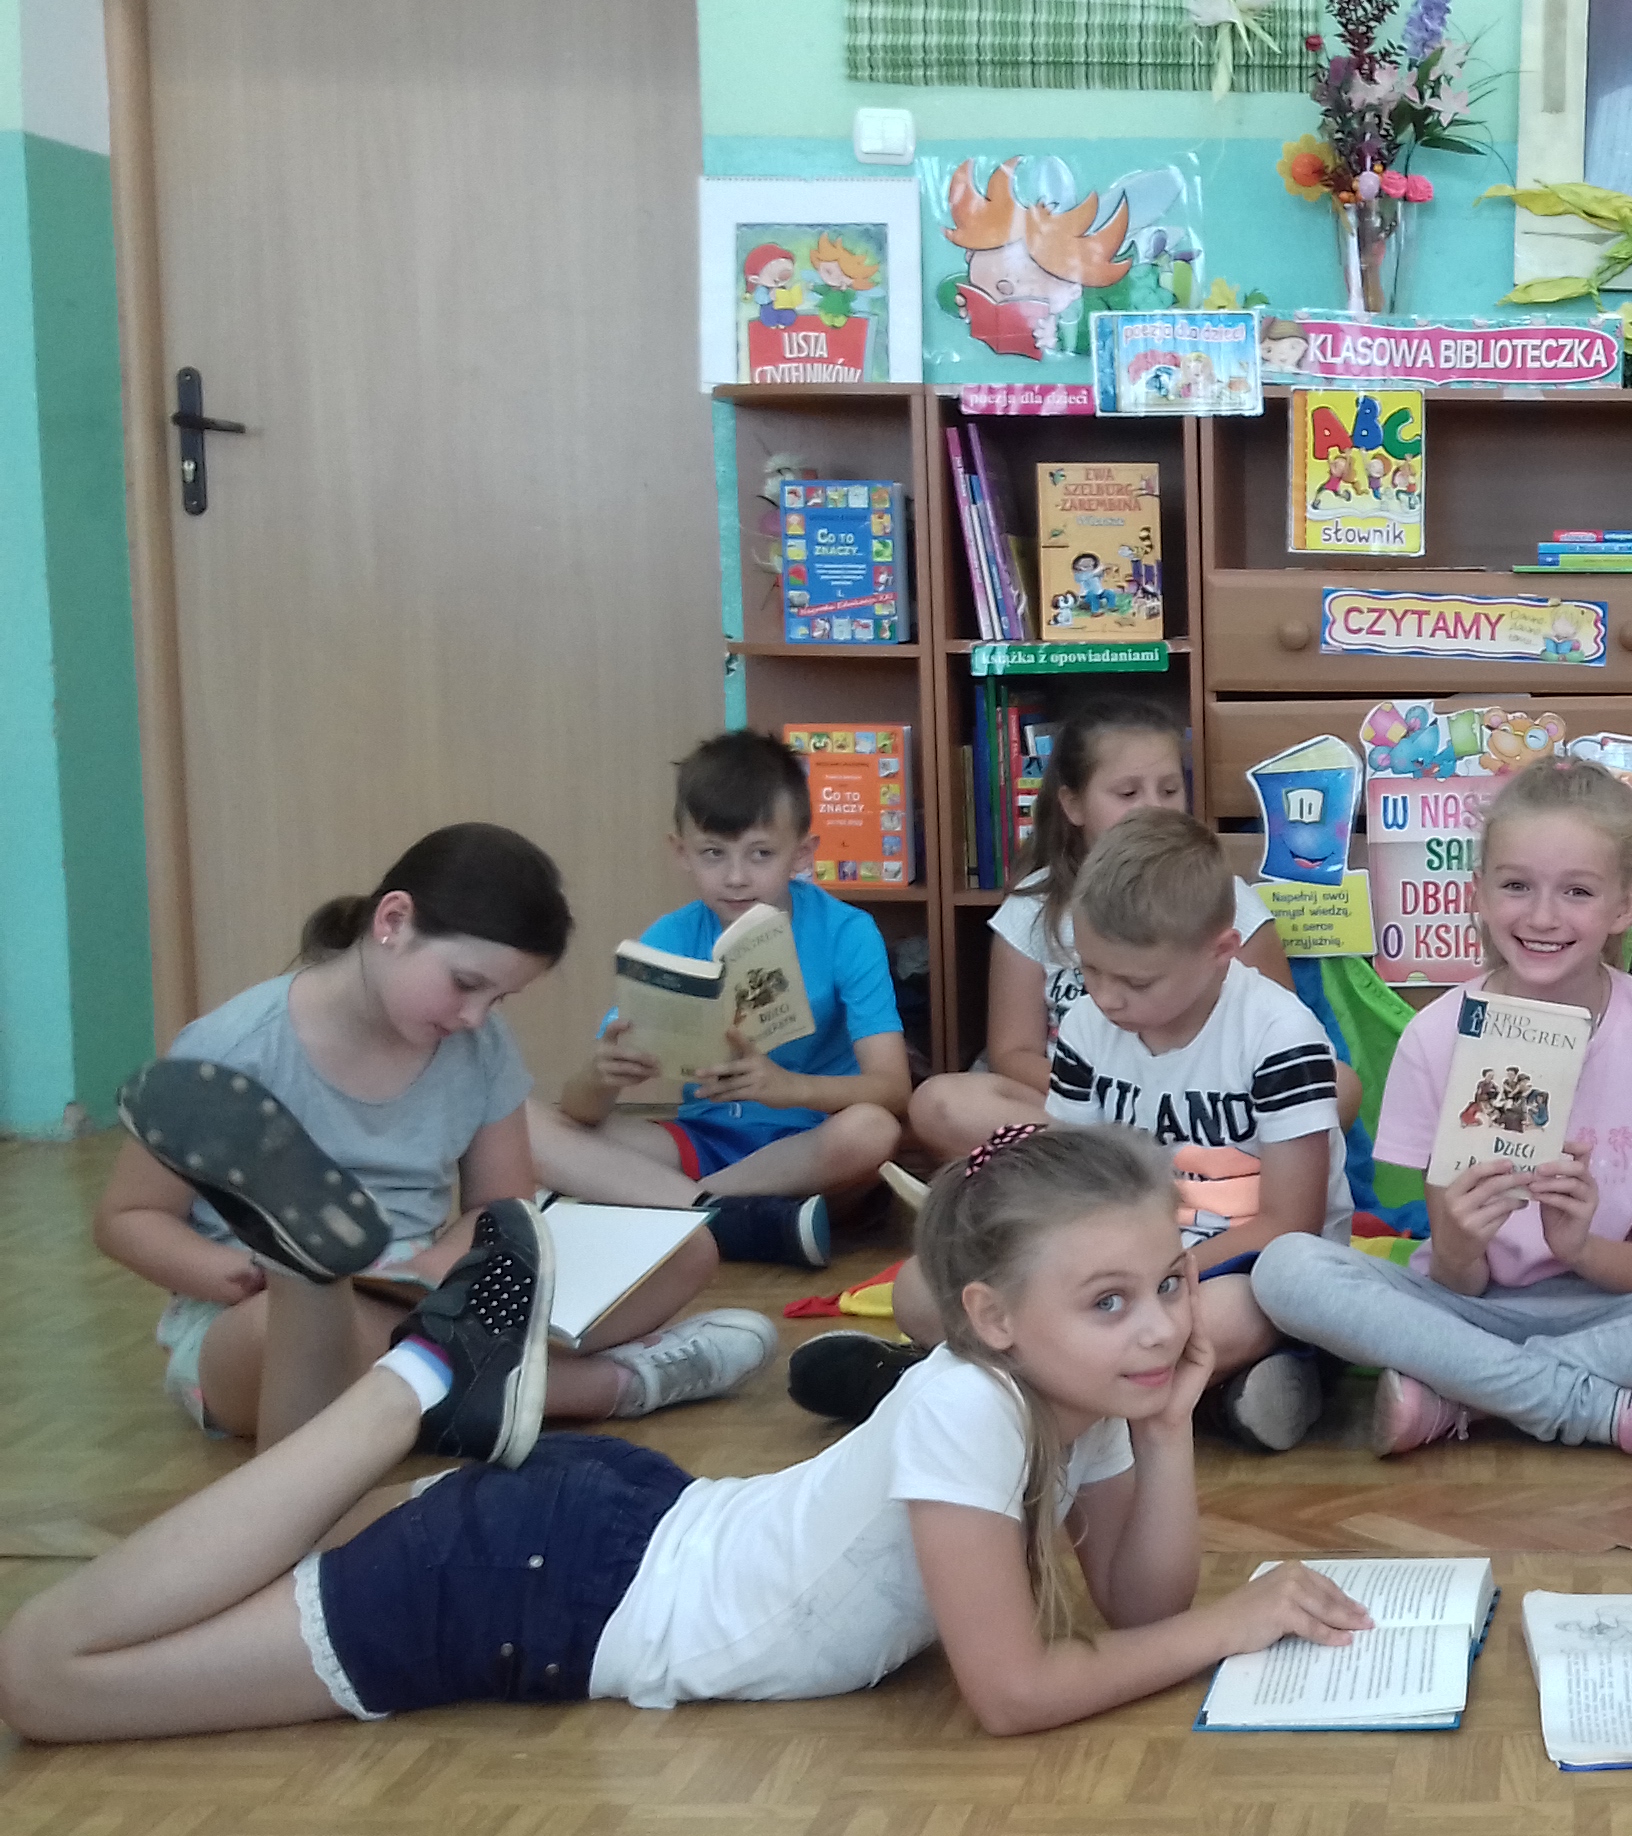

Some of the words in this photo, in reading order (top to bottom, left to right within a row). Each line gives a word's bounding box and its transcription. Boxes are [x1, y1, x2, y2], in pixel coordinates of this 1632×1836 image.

[782, 332, 828, 358] LISTA
[1123, 324, 1173, 345] poezja
[1175, 319, 1199, 341] dla
[1201, 323, 1247, 342] dzieci
[1308, 333, 1435, 368] KLASOWA
[1439, 338, 1608, 370] BIBLIOTECZKA
[754, 358, 862, 383] CZYTELNIKÓW
[1020, 390, 1043, 405] dla
[1046, 390, 1089, 406] dzieci
[1312, 395, 1422, 461] ABC
[1321, 521, 1406, 545] słownik
[1343, 606, 1506, 641] CZYTAMY
[1050, 648, 1160, 667] opowiadaniami
[1382, 795, 1409, 830] W
[1420, 794, 1490, 830] NAS
[1426, 837, 1480, 872] SAL
[1272, 890, 1318, 905] Napełnij
[1322, 889, 1349, 903] swój
[1302, 922, 1334, 932] serce
[1382, 924, 1404, 959] O
[1414, 924, 1484, 966] KSIĄ
[1471, 1004, 1531, 1027] ASTRID
[1469, 1016, 1577, 1050] LINDGREN
